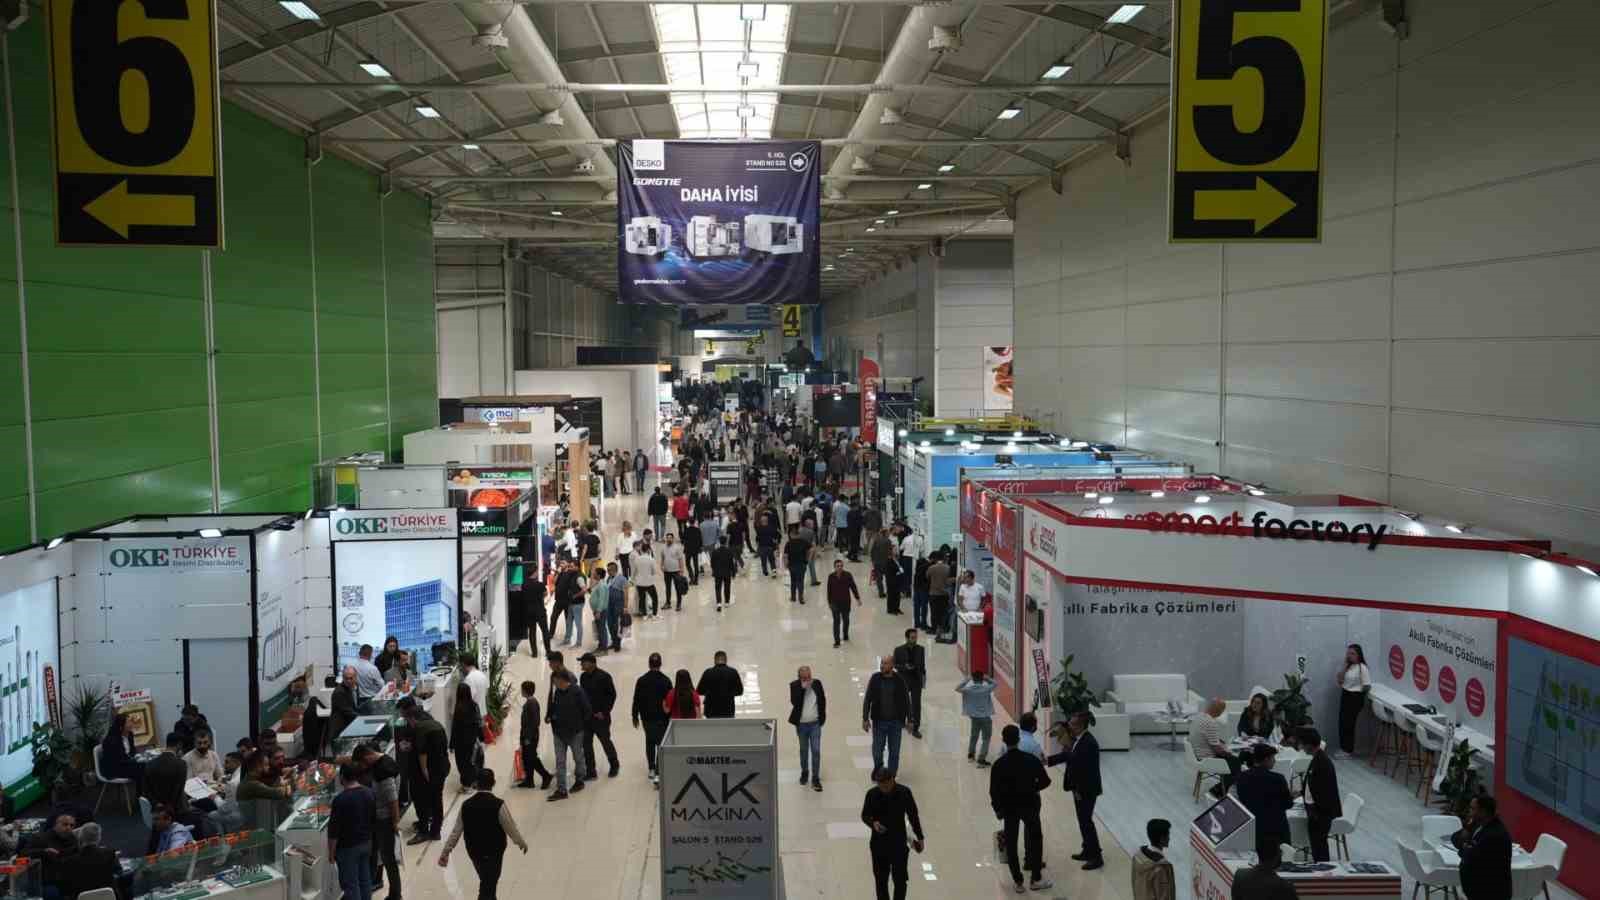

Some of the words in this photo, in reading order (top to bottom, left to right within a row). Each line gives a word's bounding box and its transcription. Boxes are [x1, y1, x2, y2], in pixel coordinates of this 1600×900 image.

[70, 0, 196, 167] 6
[1193, 0, 1306, 166] 5
[681, 189, 722, 202] DAHA
[725, 185, 758, 202] İYİSİ
[784, 306, 799, 329] 4
[336, 517, 388, 534] OKE
[391, 513, 447, 527] TÜRKİYE
[1252, 511, 1387, 550] factory
[110, 548, 169, 568] OKE
[172, 545, 238, 559] TÜRKİYE
[1090, 602, 1149, 615] Fabrika
[1154, 600, 1237, 616] Çözümleri
[1427, 635, 1454, 655] Fabrika
[1455, 646, 1495, 672] Çözümleri
[672, 772, 760, 804] AK
